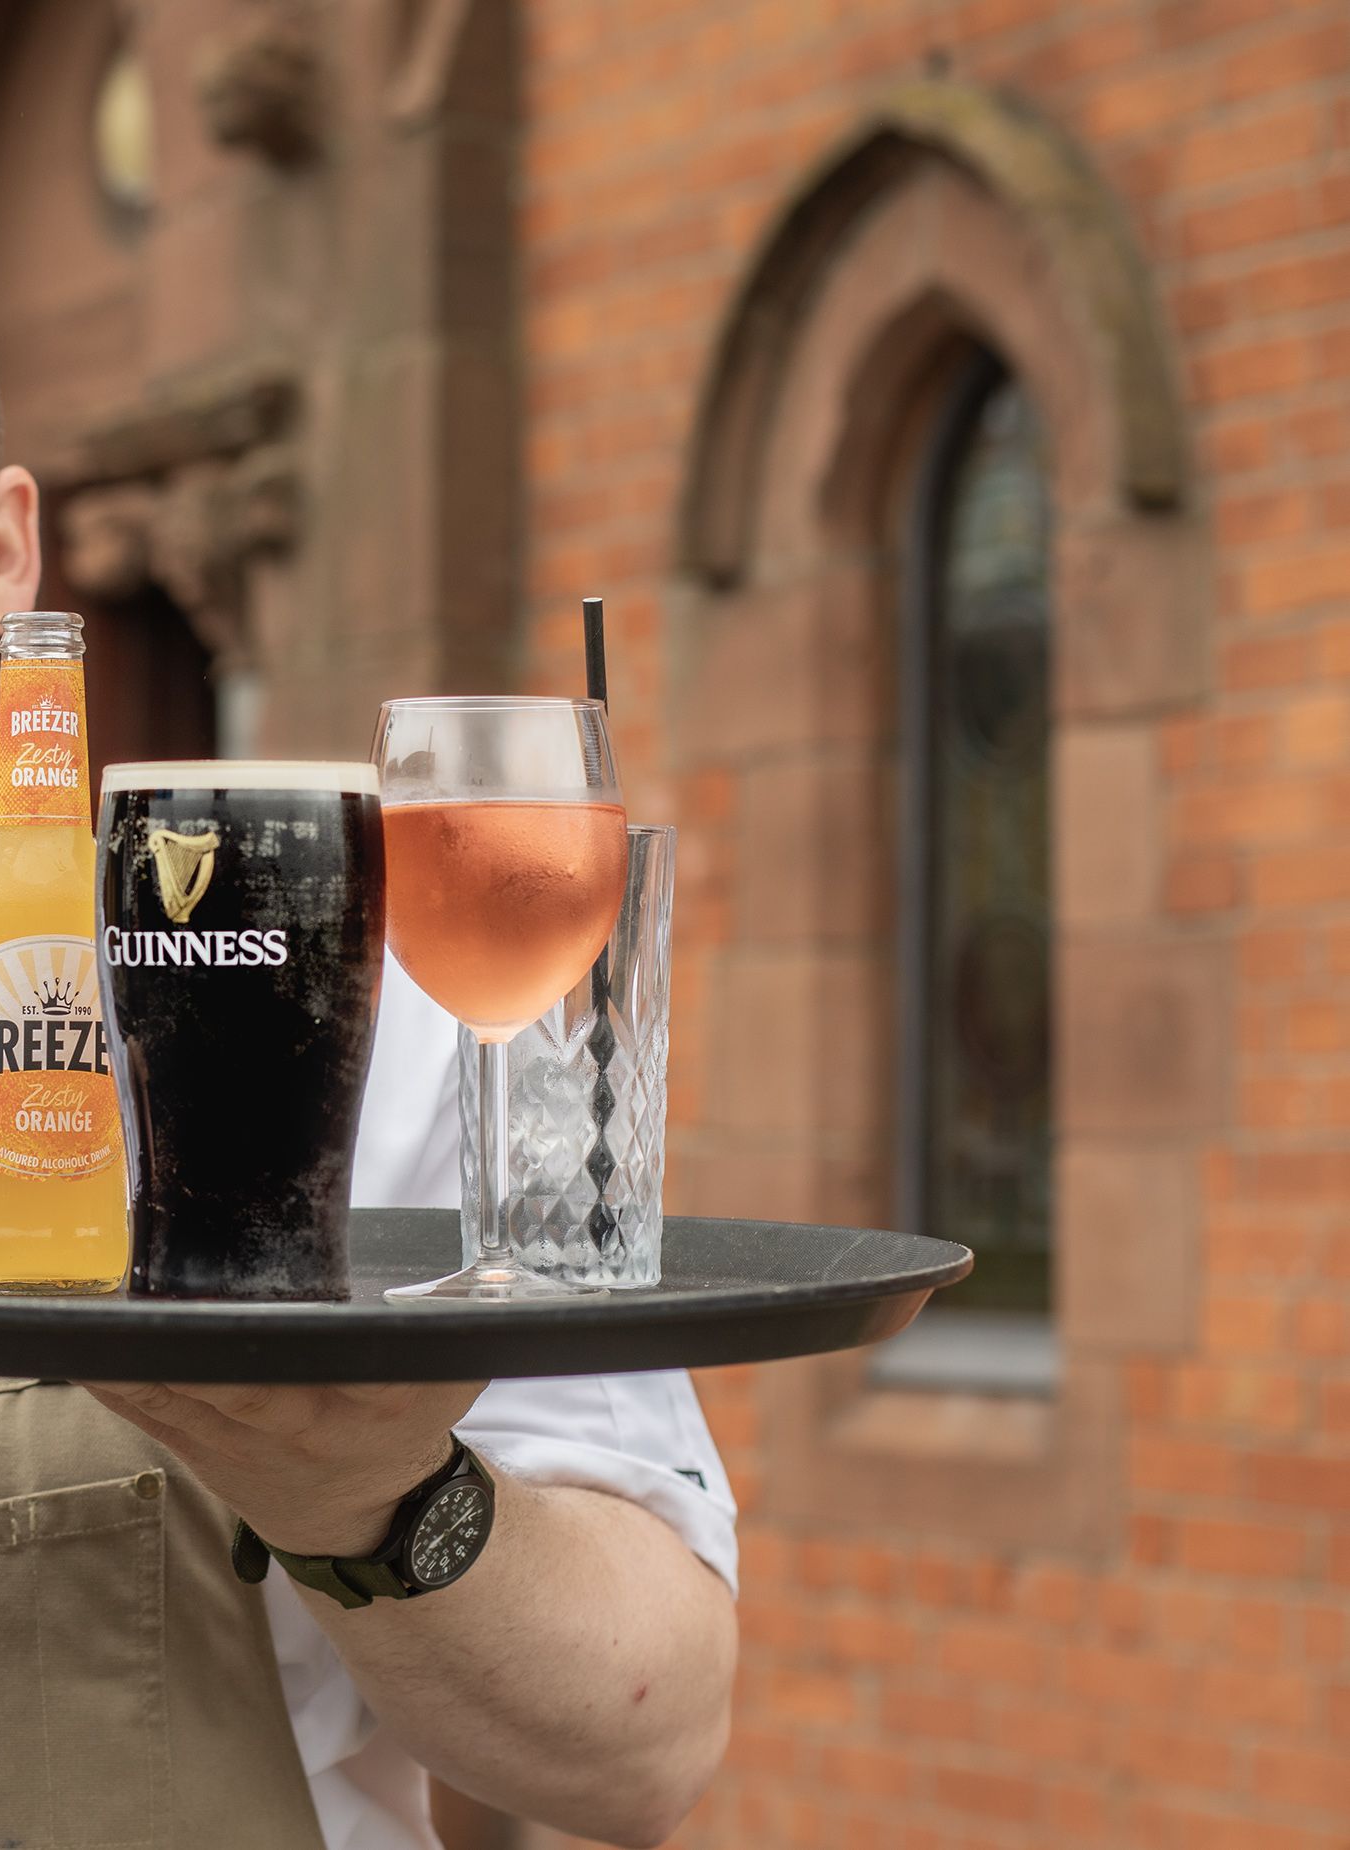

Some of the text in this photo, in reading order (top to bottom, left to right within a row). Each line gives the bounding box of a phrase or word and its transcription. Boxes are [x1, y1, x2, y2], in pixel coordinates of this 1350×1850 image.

[11, 710, 79, 738] BREEZER
[16, 742, 74, 772] Zesty
[11, 767, 79, 788] ORANGE
[104, 925, 288, 967] GUINNESS
[22, 1006, 92, 1015] EST. 1990
[22, 1083, 86, 1113] Zesty
[15, 1110, 92, 1132] ORANGE
[41, 1154, 90, 1169] ALCOHOLIC
[90, 1144, 111, 1165] DRINK
